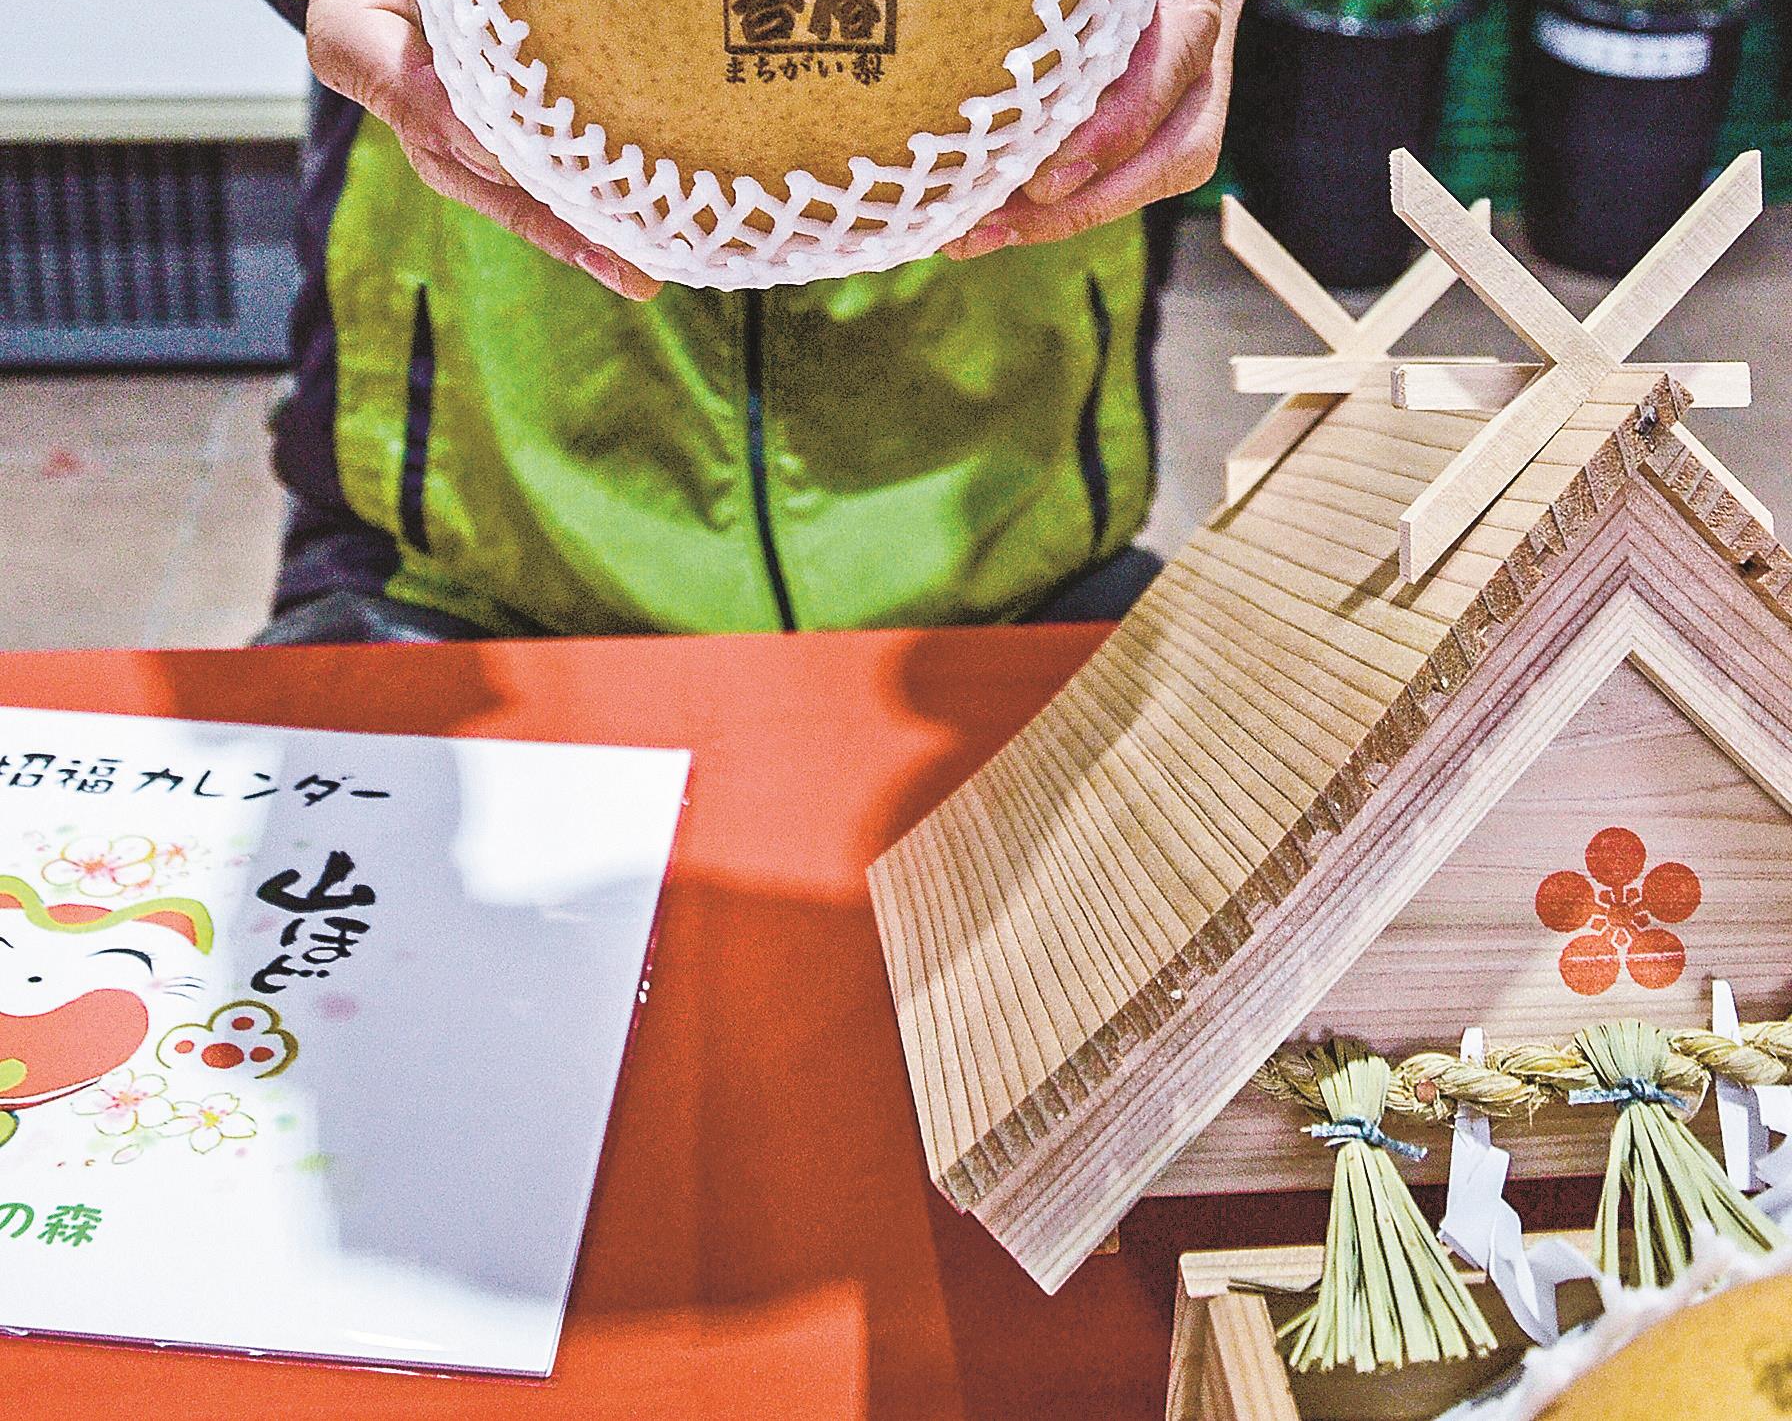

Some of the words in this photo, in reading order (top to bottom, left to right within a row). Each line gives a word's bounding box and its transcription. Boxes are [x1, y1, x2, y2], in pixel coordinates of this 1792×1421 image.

[726, 53, 886, 85] まちがい梨
[250, 850, 376, 994] 山ほど
[0, 1202, 102, 1247] の森
